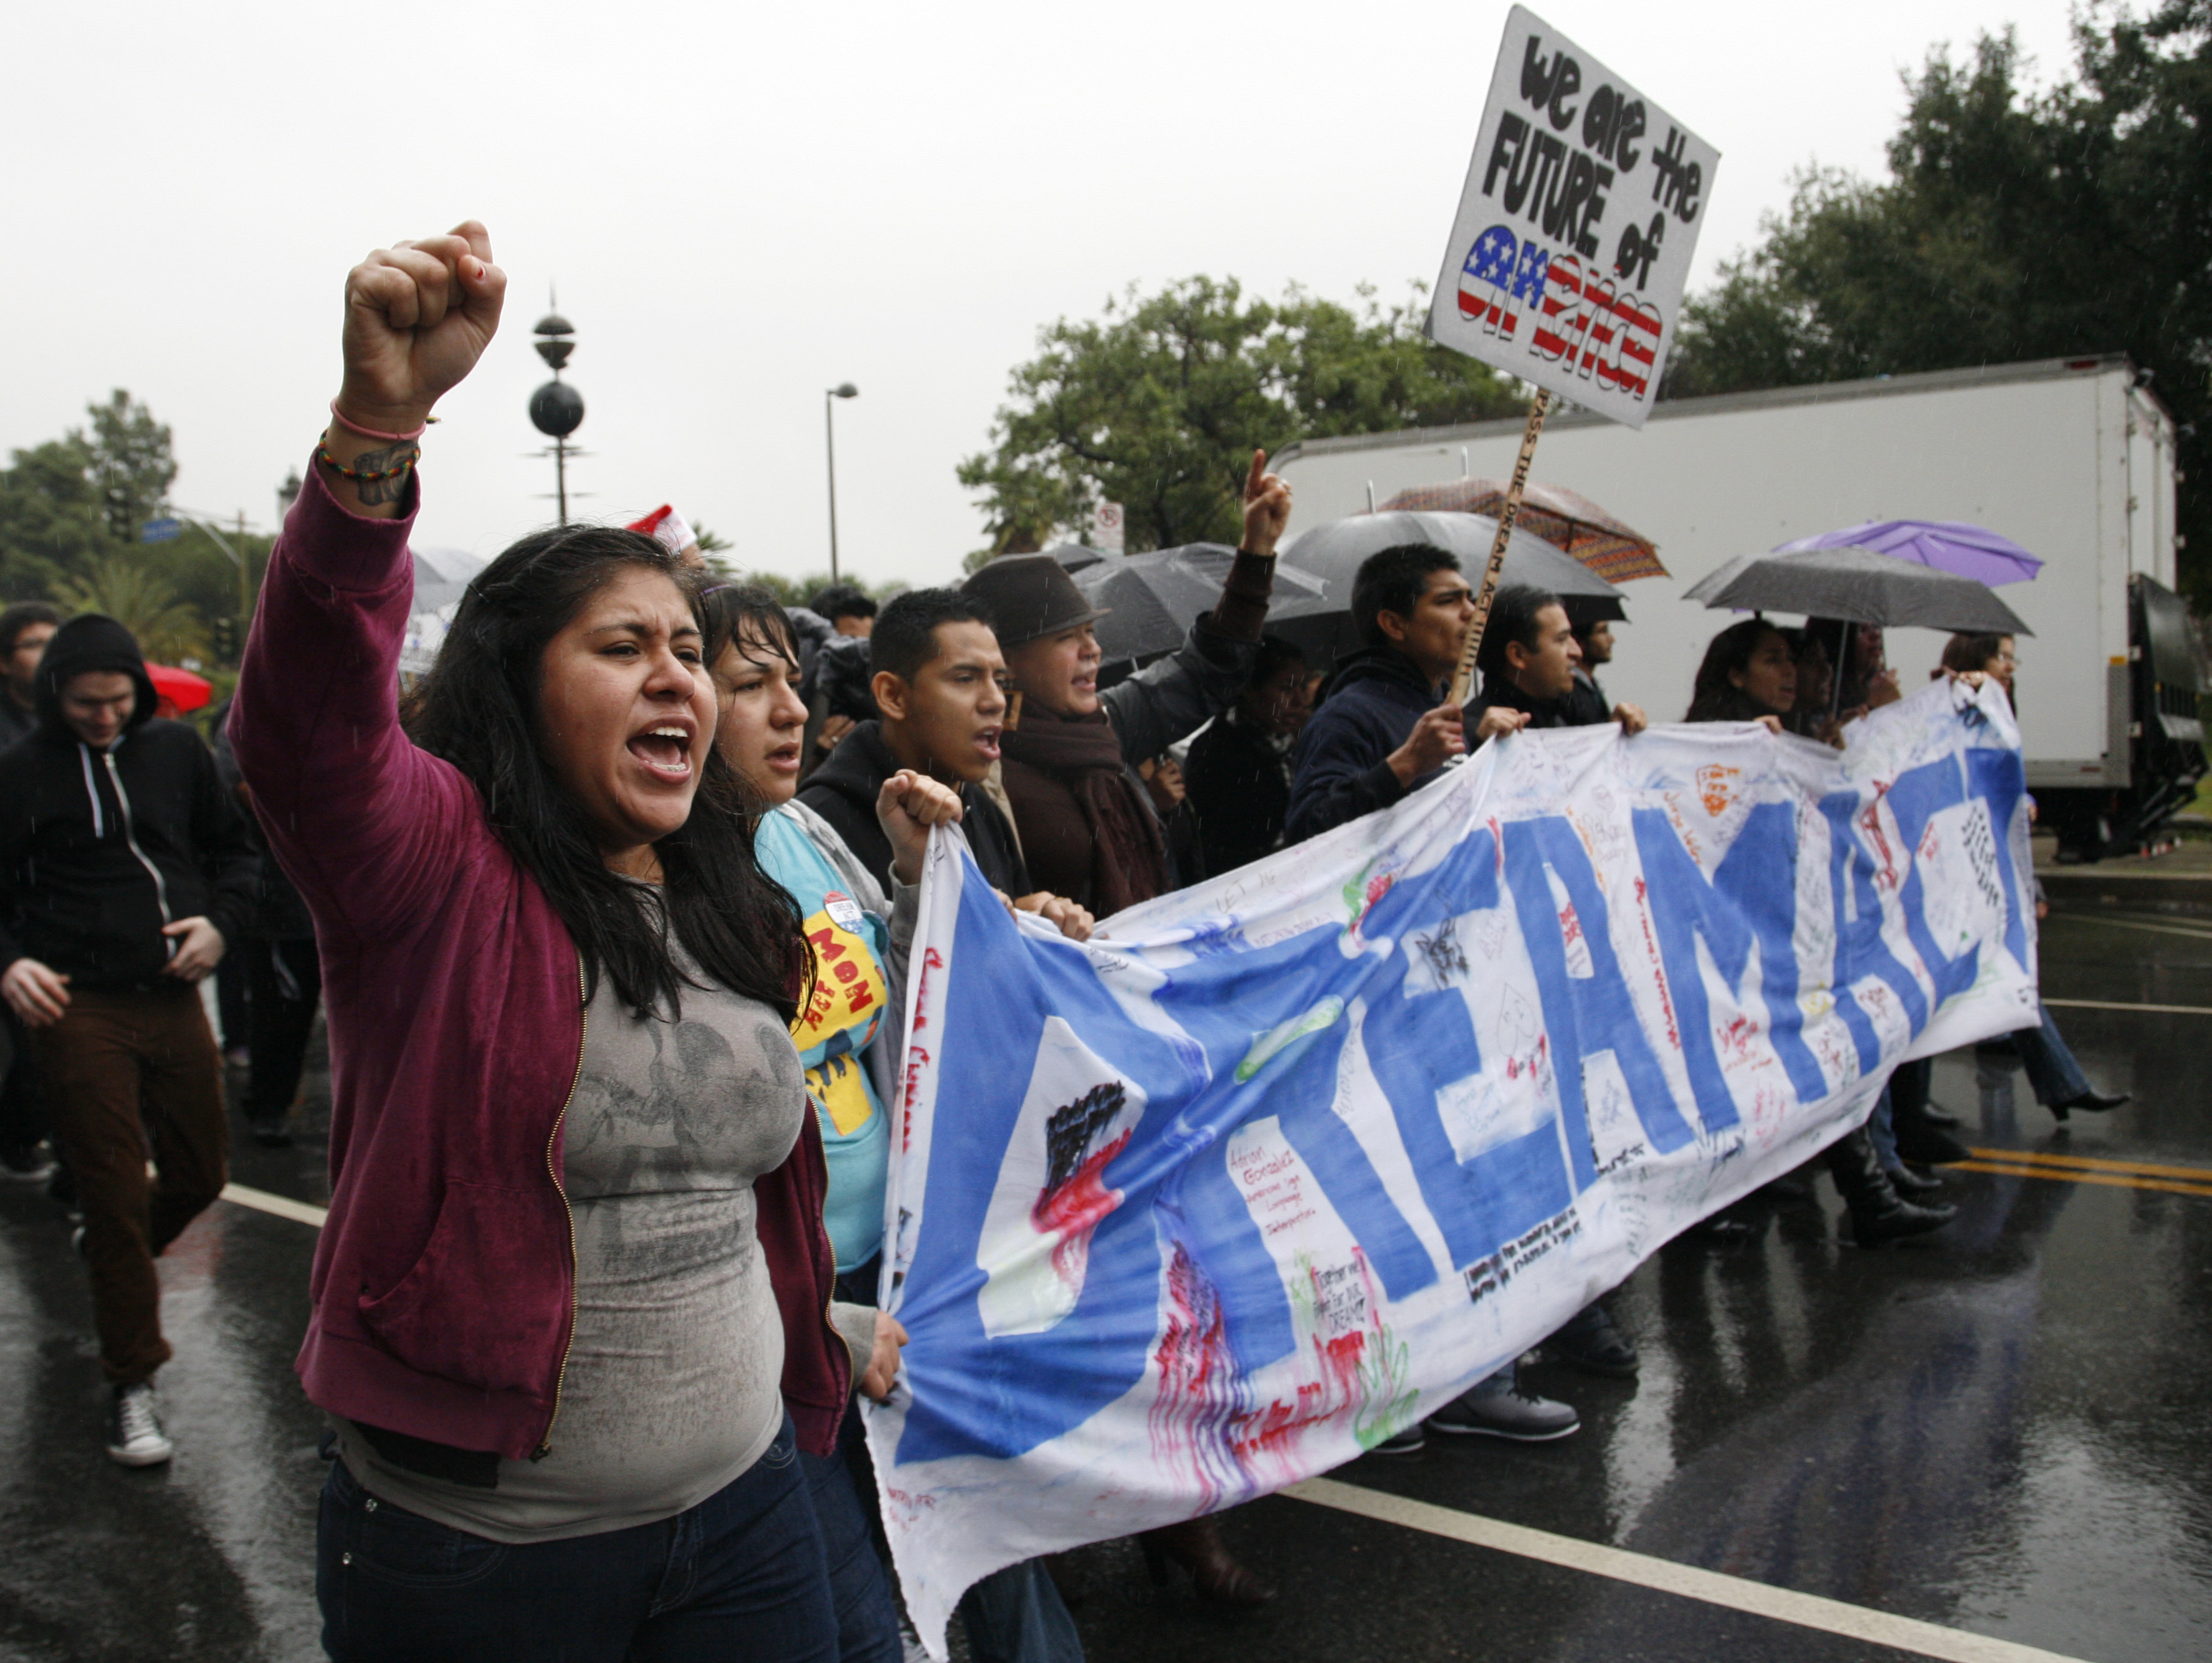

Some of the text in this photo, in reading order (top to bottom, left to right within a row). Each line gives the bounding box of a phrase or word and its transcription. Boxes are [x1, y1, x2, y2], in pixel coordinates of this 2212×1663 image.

[1583, 84, 1645, 173] are
[1652, 125, 1701, 223] the
[1482, 109, 1665, 290] FUTURE of
[1526, 392, 1549, 444] PASS
[1513, 452, 1532, 497] THE
[1489, 502, 1517, 573] DREAM
[808, 927, 874, 1014] MON
